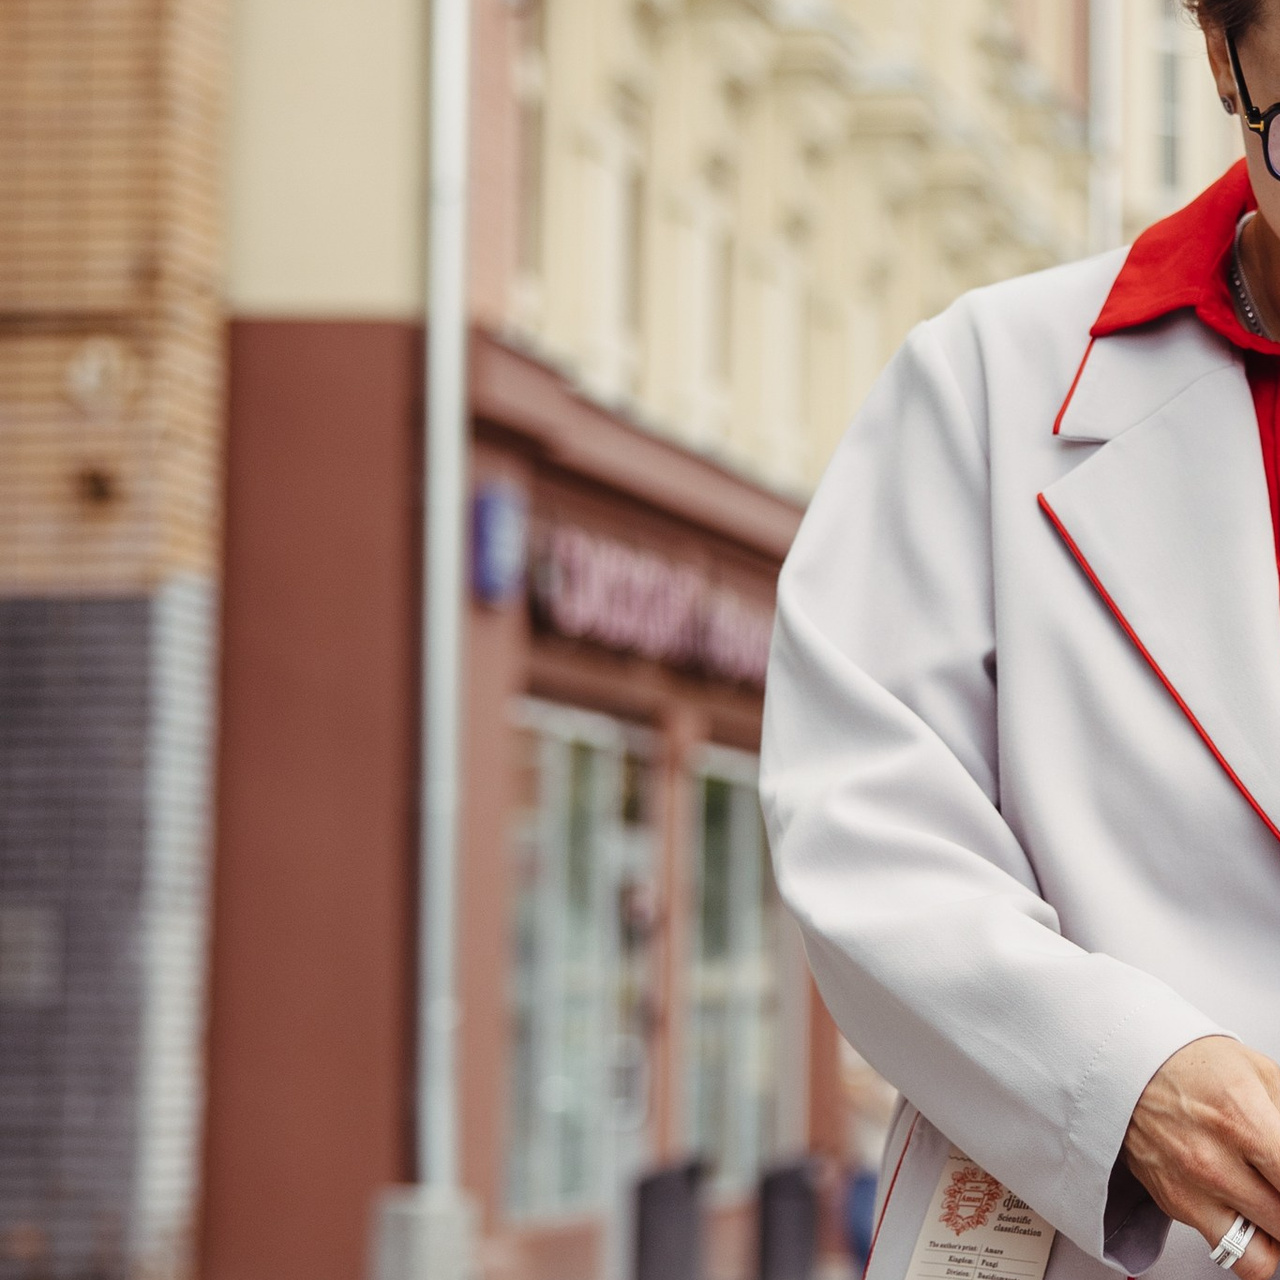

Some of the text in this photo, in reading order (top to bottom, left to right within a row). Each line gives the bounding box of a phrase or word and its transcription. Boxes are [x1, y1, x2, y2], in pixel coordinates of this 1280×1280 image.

[1003, 1195, 1034, 1211] djam
[997, 1213, 1032, 1225] Scientific
[994, 1224, 1042, 1237] classification
[984, 1247, 1004, 1255] Amare
[948, 1255, 973, 1264] Kingdom:
[981, 1260, 999, 1268] Fungi
[946, 1268, 970, 1277] Division:
